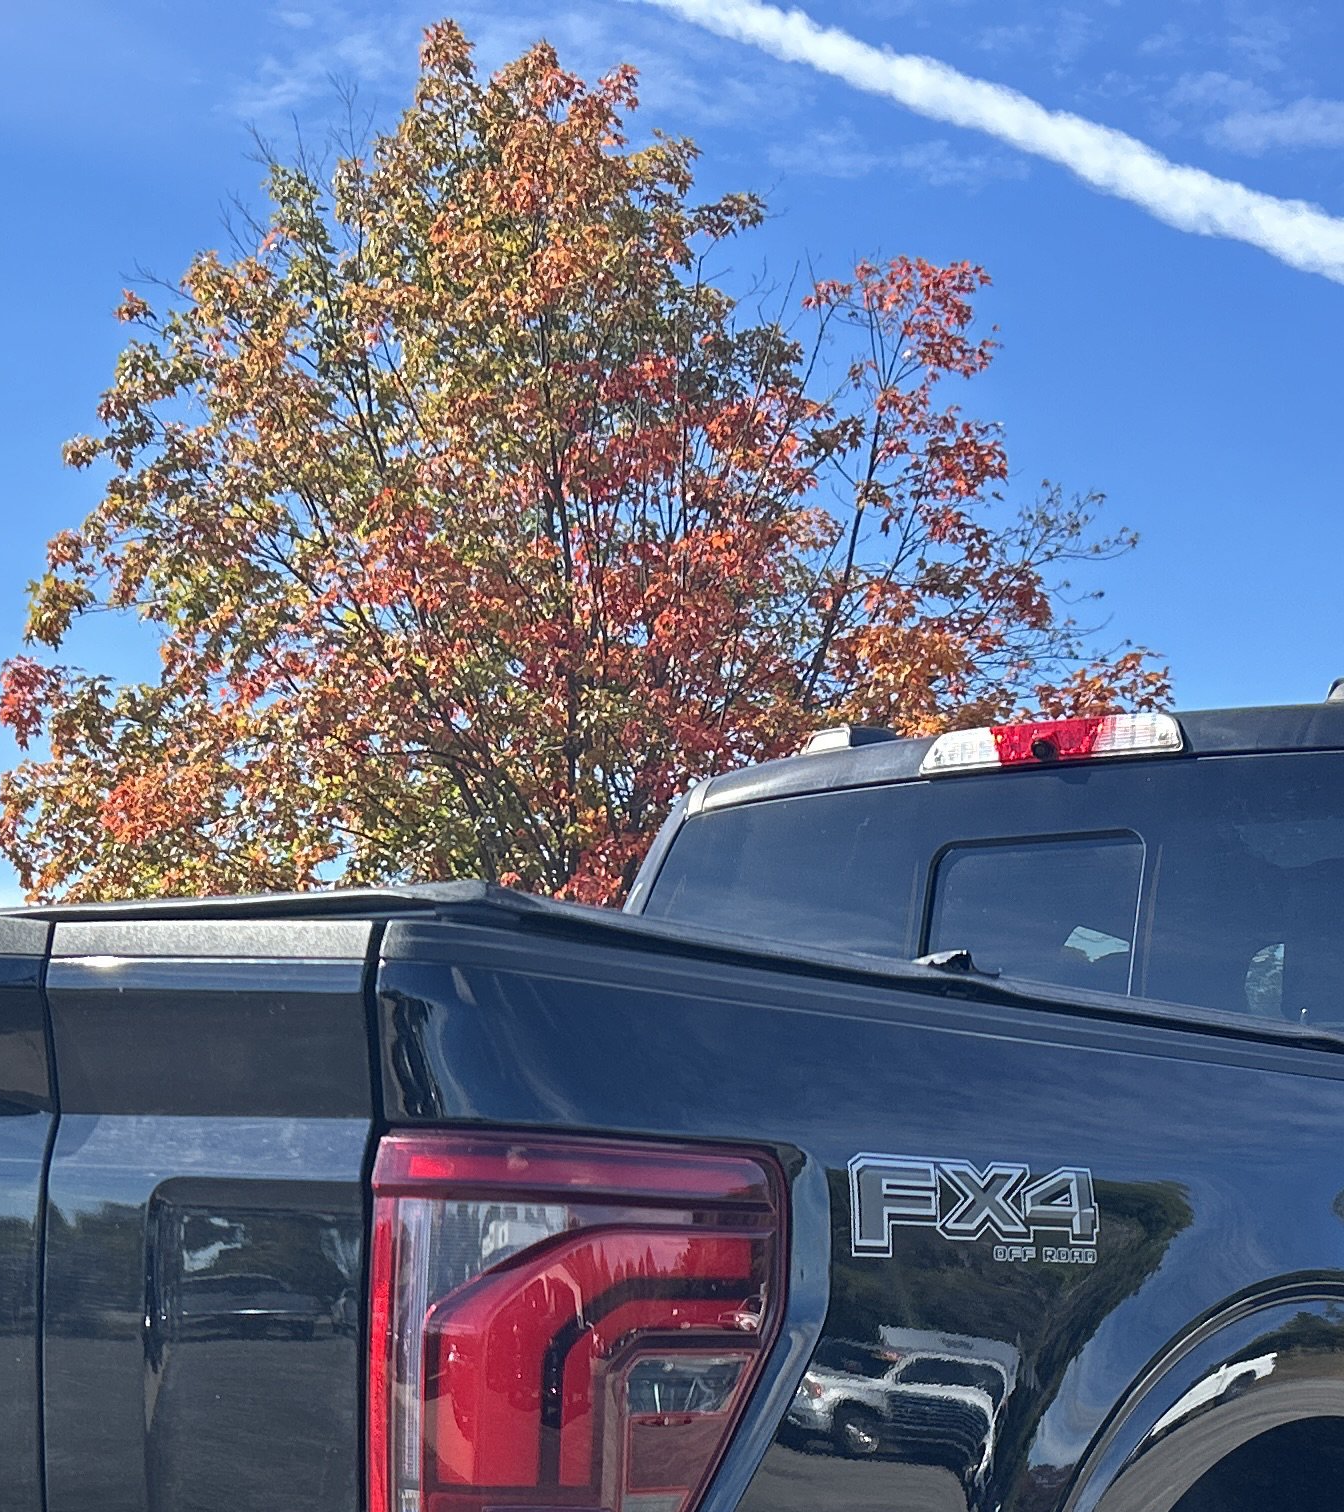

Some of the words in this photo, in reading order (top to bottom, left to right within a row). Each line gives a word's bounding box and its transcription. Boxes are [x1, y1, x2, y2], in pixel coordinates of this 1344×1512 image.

[848, 1152, 1100, 1257] FX4
[993, 1245, 1036, 1262] OFF
[1042, 1247, 1098, 1264] ROAD
